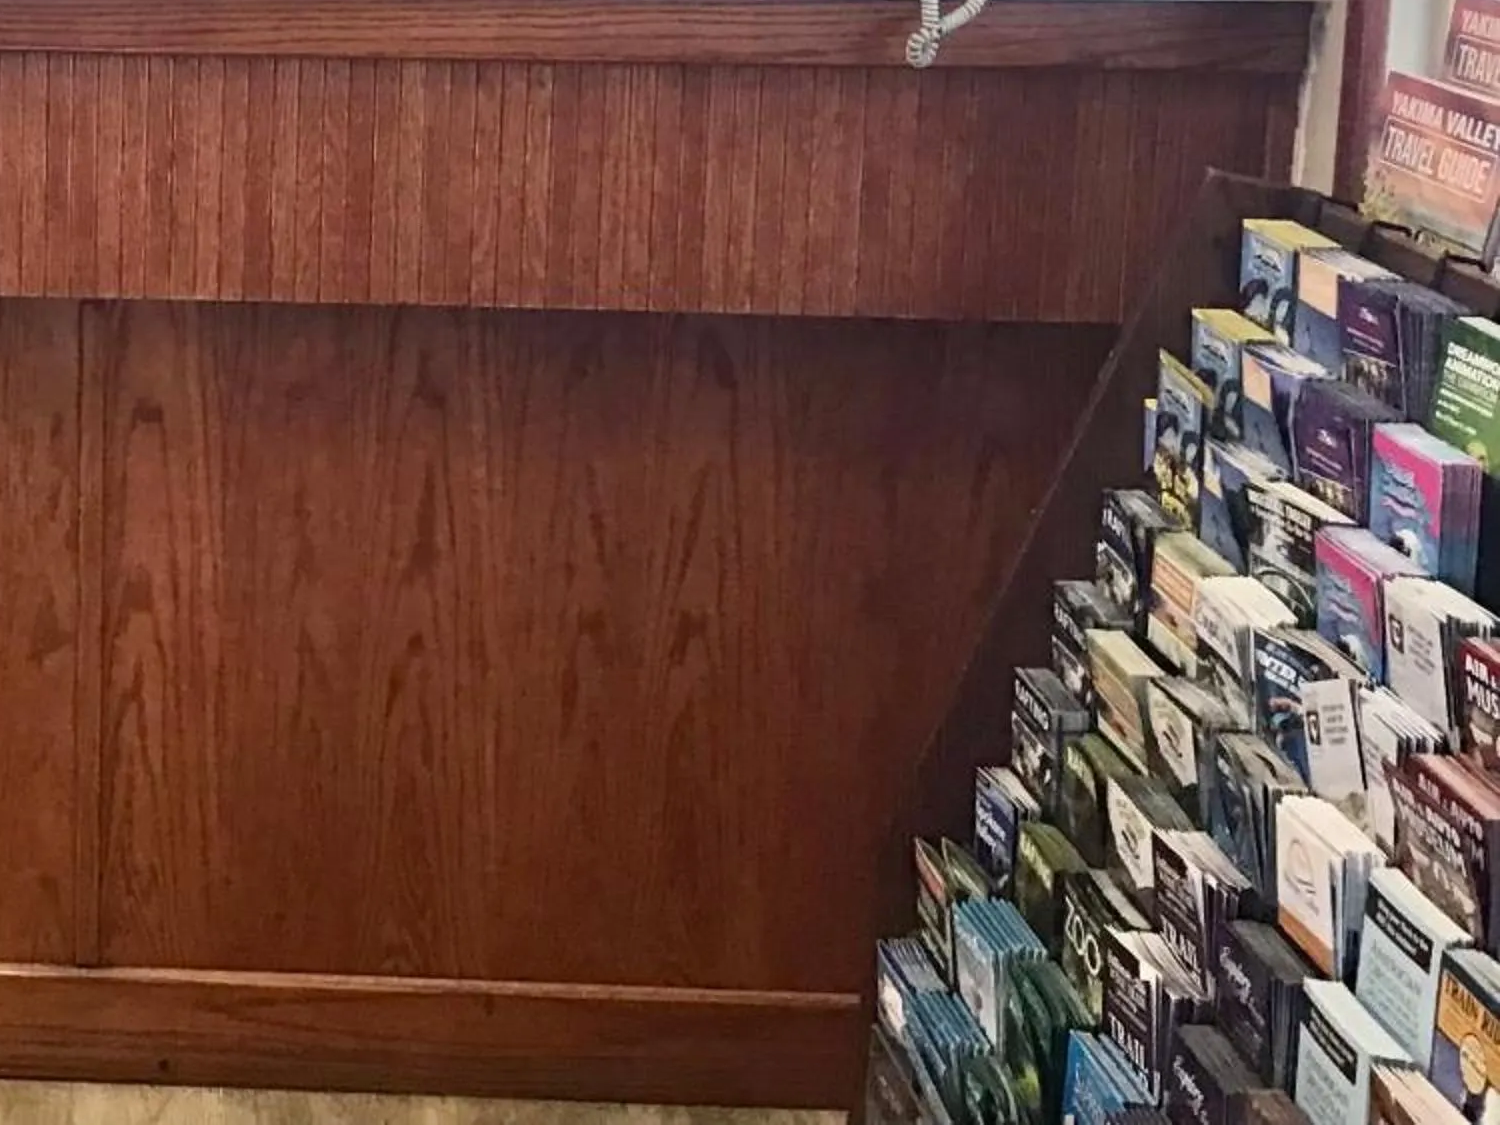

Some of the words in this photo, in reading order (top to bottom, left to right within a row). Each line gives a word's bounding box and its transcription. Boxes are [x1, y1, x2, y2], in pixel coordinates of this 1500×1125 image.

[1391, 90, 1444, 131] YAKIMA
[1446, 109, 1500, 150] VALLEY
[1383, 125, 1435, 175] TRAVEL
[1437, 147, 1491, 193] GUIDE
[1065, 895, 1101, 976] ZOO
